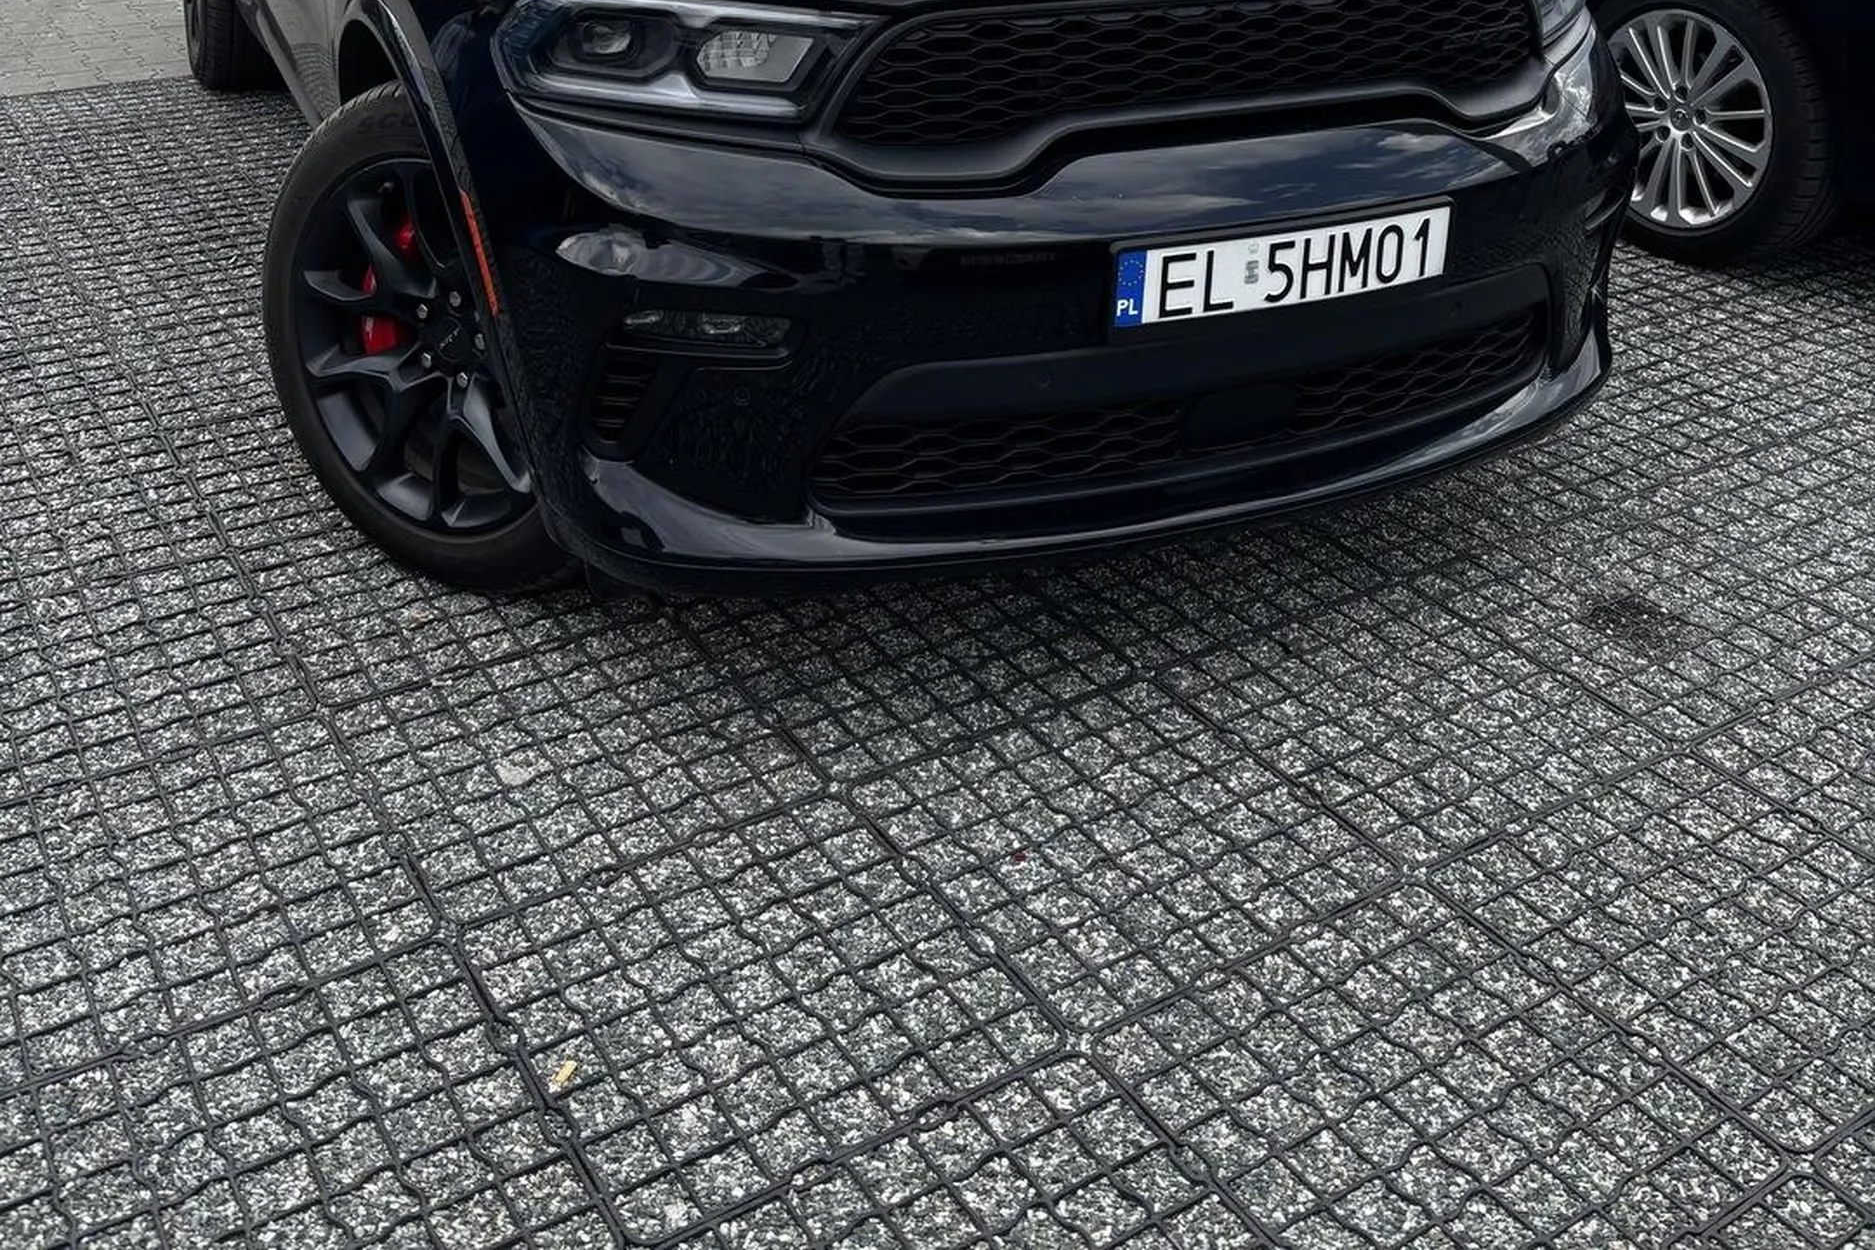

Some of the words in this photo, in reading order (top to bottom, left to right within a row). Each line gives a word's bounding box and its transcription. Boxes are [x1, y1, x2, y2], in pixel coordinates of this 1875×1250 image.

[1159, 250, 1234, 319] EL
[1263, 218, 1431, 303] 5HM01
[1116, 299, 1139, 317] PL
